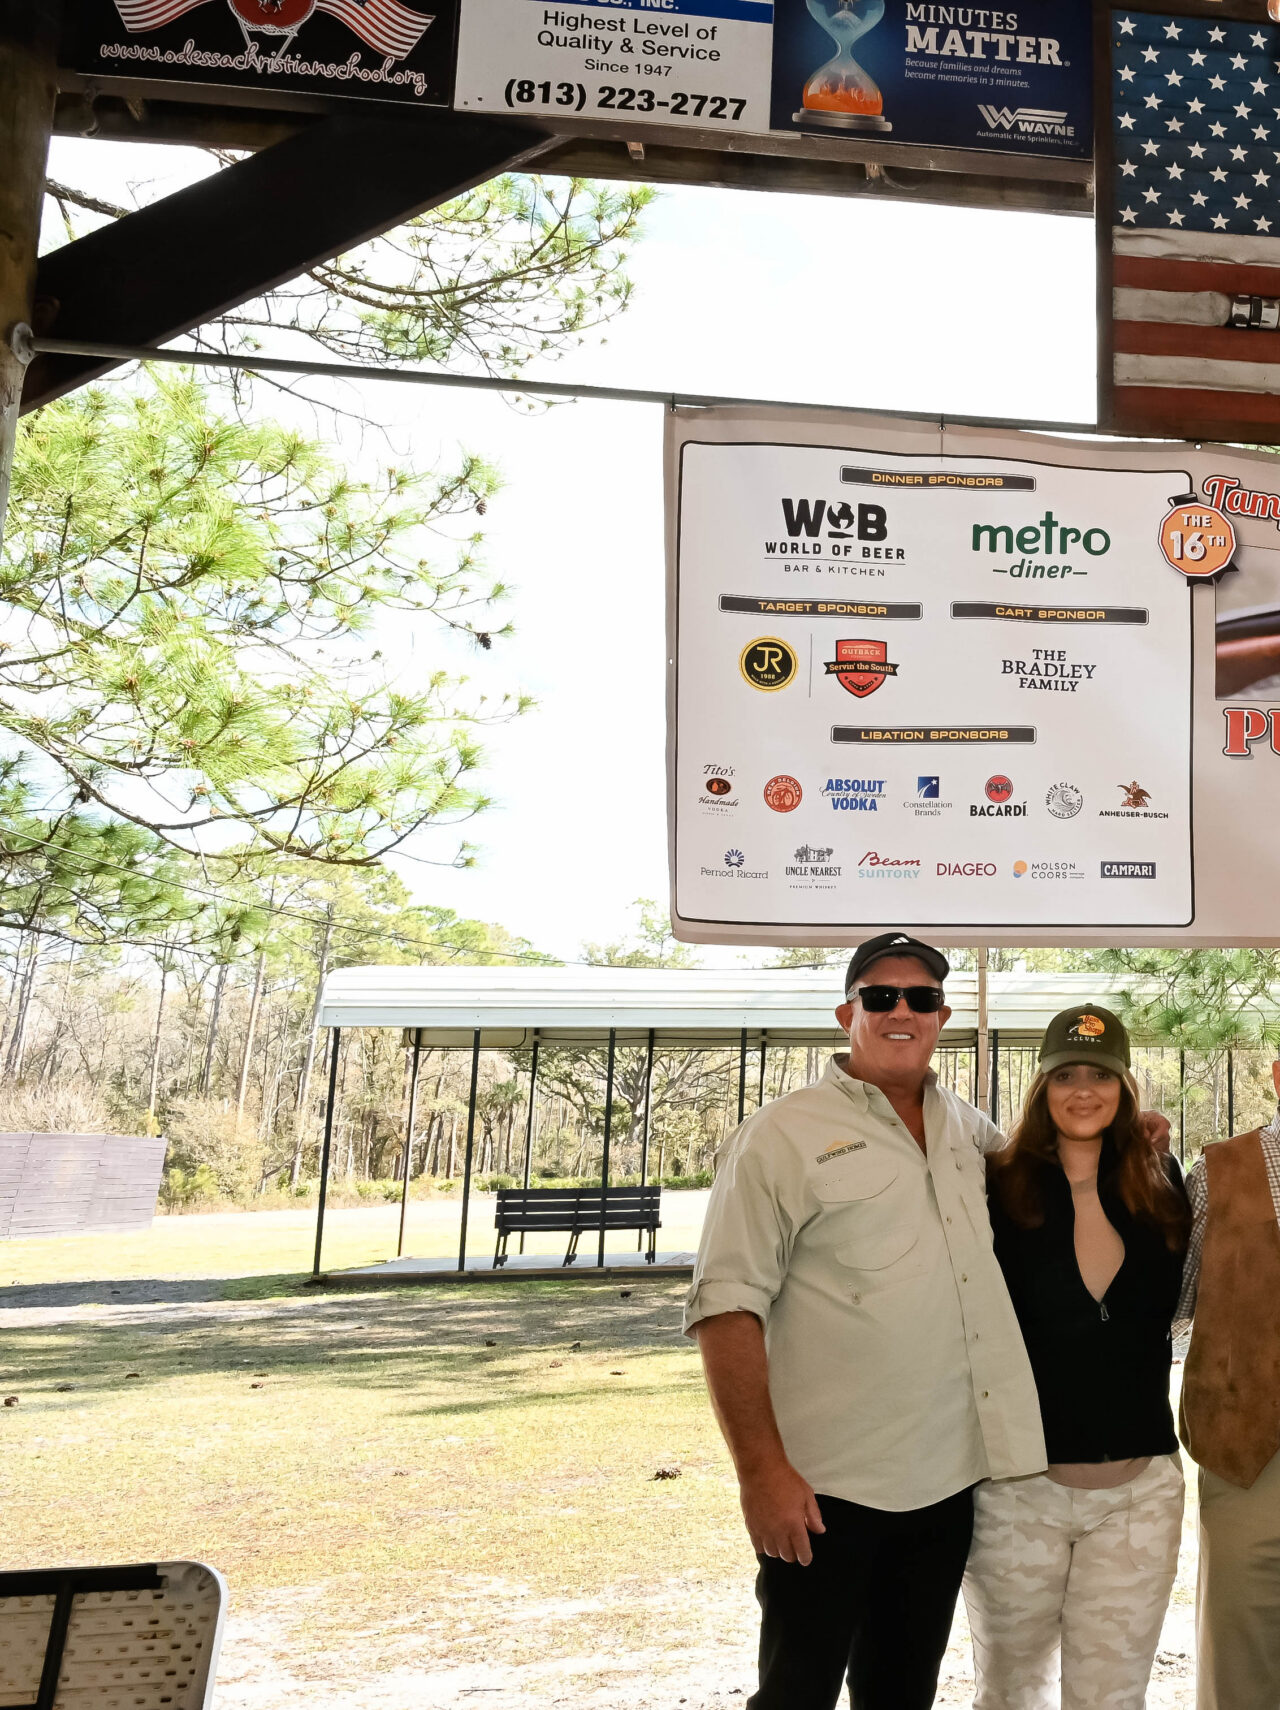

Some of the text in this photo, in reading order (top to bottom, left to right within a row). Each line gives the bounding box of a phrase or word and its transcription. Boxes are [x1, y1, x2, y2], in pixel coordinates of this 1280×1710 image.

[905, 2, 1019, 31] MINUTES
[543, 10, 717, 41] Highest Level of
[537, 30, 721, 61] Quality & Service
[905, 25, 1063, 66] MATTER
[100, 39, 427, 96] www.odessachristianschool.org
[584, 58, 672, 77] Since 1947
[905, 58, 1022, 76] Because families and dreams
[904, 69, 1030, 89] become memories minutes.
[504, 79, 747, 121] (813) 223-2727
[1018, 121, 1075, 137] WAYNE
[872, 473, 1004, 486] DINNER SPONSORS
[1181, 513, 1212, 528] THE
[972, 511, 1111, 556] metro
[765, 541, 905, 560] WORLD OF BEER
[784, 564, 885, 577] BAR & KITCHEN
[758, 601, 888, 615] TARGET SPONSOR
[995, 607, 1106, 620] CART SPONSOR
[841, 648, 881, 656] OUTBACK
[1032, 649, 1067, 662] THE
[856, 663, 894, 673] the South
[1001, 659, 1097, 680] BRADLEY
[1018, 677, 1080, 692] FAMILY
[861, 730, 1009, 740] LIBATION SPONSORS
[703, 764, 736, 777] Tito's
[826, 778, 884, 793] ABSOLUT
[698, 796, 739, 807] Handmade
[831, 797, 878, 811] VODKA
[903, 801, 953, 809] Constellation
[969, 801, 1028, 817] BACARDÍ
[1099, 810, 1169, 819] ANHEUSER-BUSCH
[858, 851, 922, 867] Beam
[700, 867, 769, 880] Pernod Ricard
[785, 866, 842, 876] UNCLE NEAREST
[858, 868, 921, 879] SUNTORY
[936, 863, 997, 876] DIAGEO
[1032, 862, 1076, 871] MOLSON
[1104, 864, 1153, 876] CAMPARI
[1032, 871, 1068, 879] COORS
